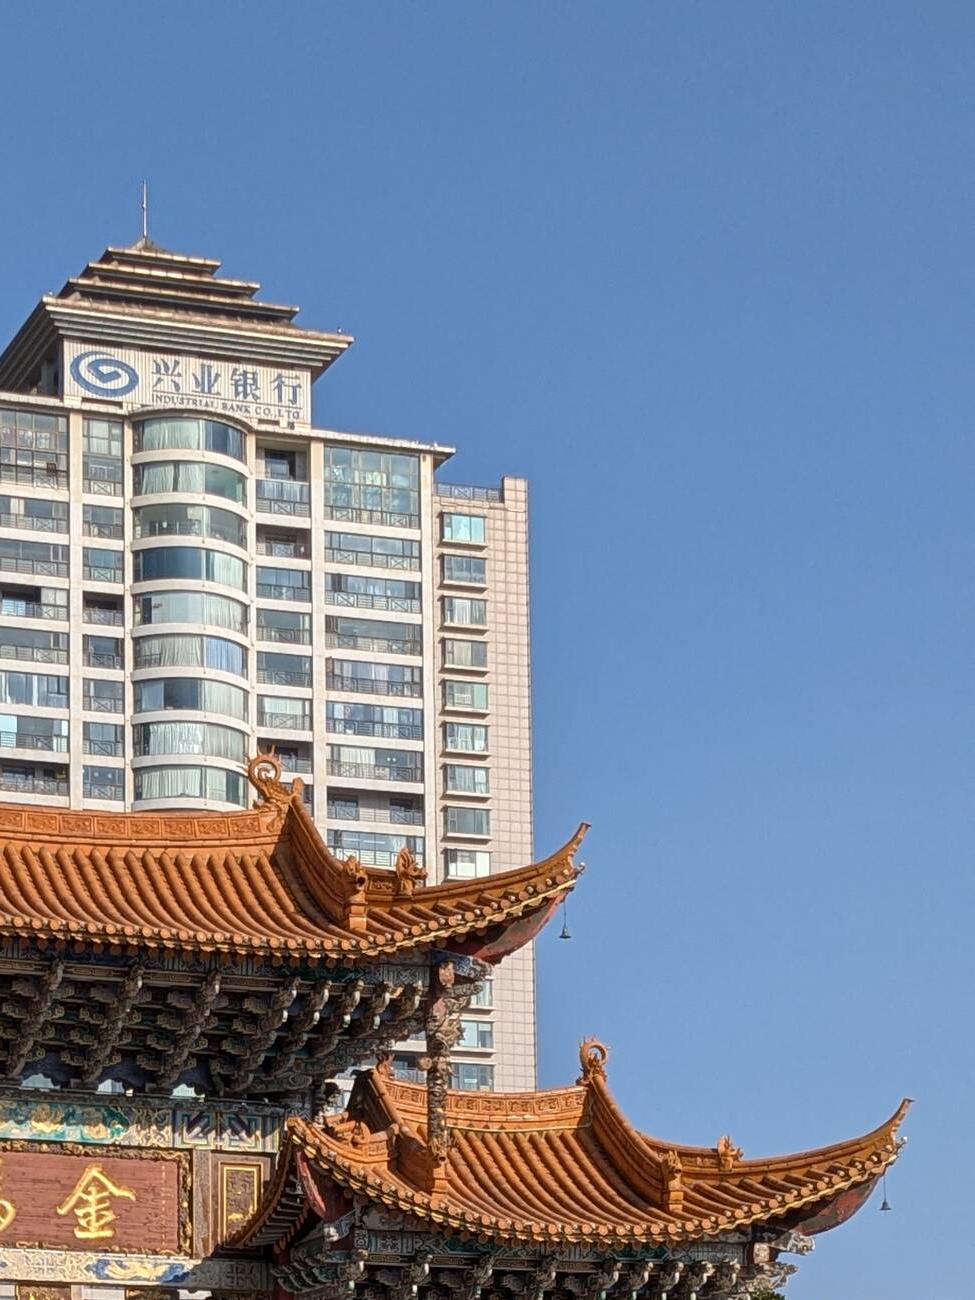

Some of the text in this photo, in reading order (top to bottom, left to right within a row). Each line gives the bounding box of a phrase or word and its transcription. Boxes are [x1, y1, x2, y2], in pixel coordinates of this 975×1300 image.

[151, 358, 303, 405] 兴业银行
[151, 393, 218, 410] INDUSTRIAL
[222, 402, 250, 415] BANK
